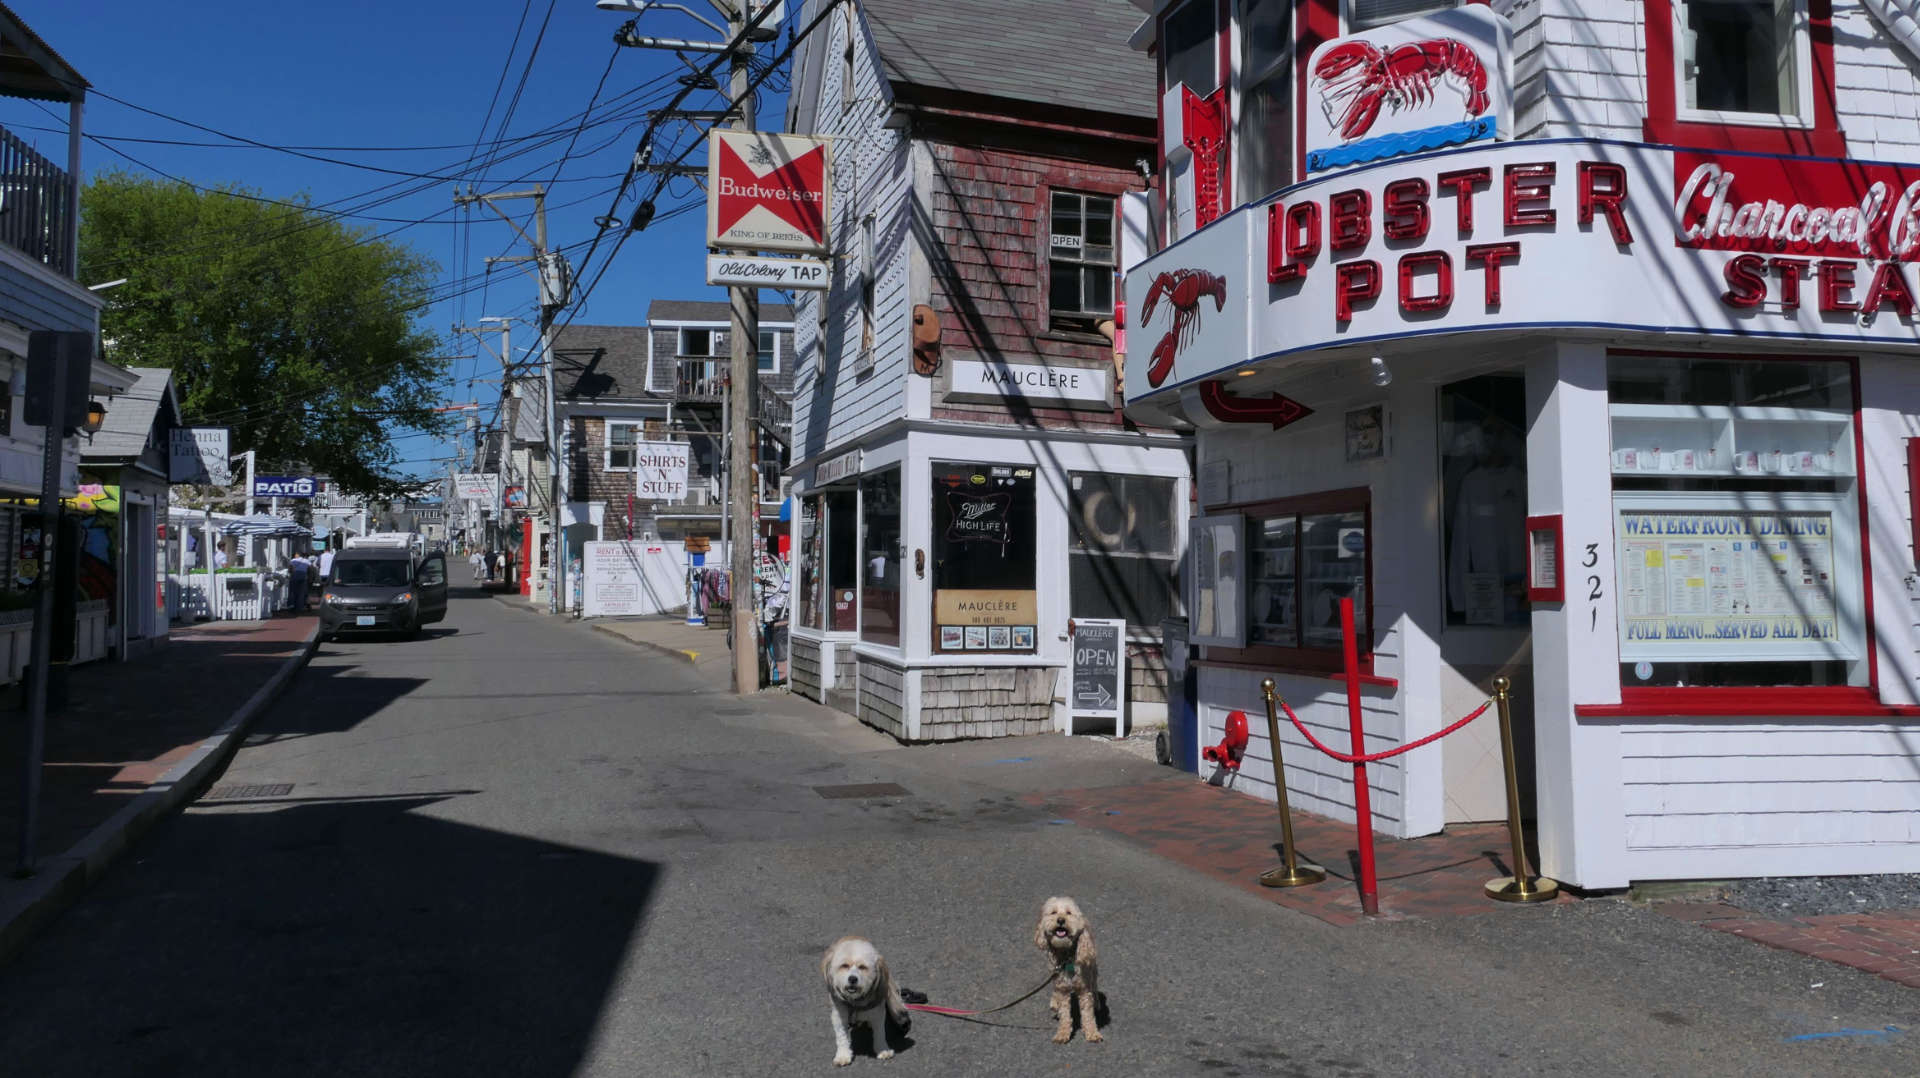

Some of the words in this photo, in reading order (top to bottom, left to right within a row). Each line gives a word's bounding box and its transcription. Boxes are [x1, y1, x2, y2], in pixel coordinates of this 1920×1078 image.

[720, 177, 822, 202] Budweiser
[1674, 162, 1889, 257] Charcoal
[1267, 160, 1632, 283] LOBSTER
[730, 230, 755, 238] KING
[757, 231, 771, 240] OF
[772, 233, 803, 241] BEERS
[1052, 235, 1080, 246] OPEN
[719, 262, 744, 276] Old
[744, 264, 788, 281] Colony
[791, 266, 822, 280] TAP
[1334, 241, 1520, 323] POT
[1721, 252, 1920, 316] STEA
[981, 368, 1079, 389] MAUCLÈRE
[171, 428, 222, 442] Henna
[171, 444, 220, 457] Tattoo
[640, 454, 687, 468] SHIRTS
[256, 482, 313, 493] PATIO
[642, 480, 683, 494] STUFF
[962, 502, 997, 520] Miller
[956, 519, 980, 530] HIGH
[980, 521, 1001, 532] LIFE
[1624, 515, 1752, 536] WATERFRONT
[1759, 517, 1828, 536] DINING
[958, 600, 1017, 611] MAUCLÈRE
[1627, 621, 1661, 640] FULL
[1772, 620, 1798, 639] ALL
[1802, 620, 1834, 639] DAY!
[1076, 647, 1116, 667] OPEN
